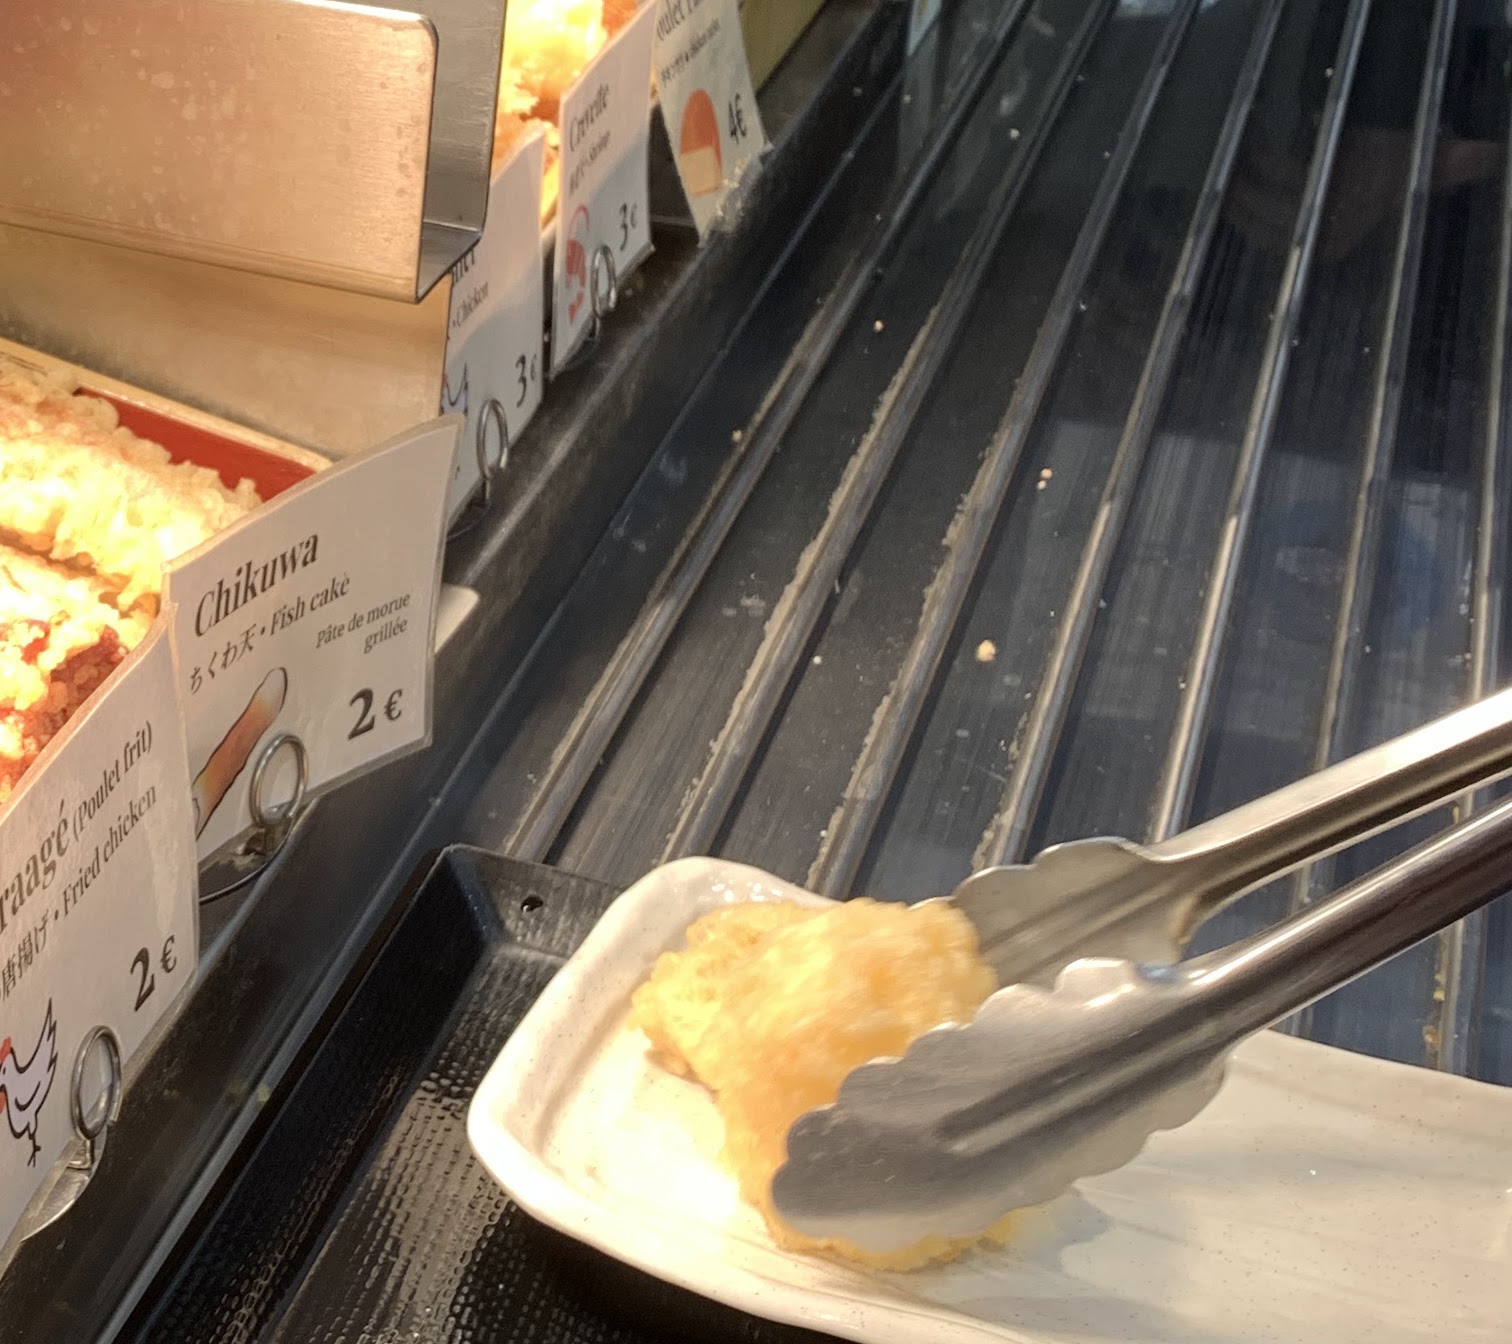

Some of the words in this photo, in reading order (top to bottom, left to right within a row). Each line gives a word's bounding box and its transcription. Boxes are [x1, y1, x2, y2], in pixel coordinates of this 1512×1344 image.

[569, 82, 610, 152] Crevette
[515, 353, 527, 408] 3
[195, 533, 319, 638] Chikuwa
[190, 623, 257, 695] ちくわ天
[269, 596, 306, 636] Fish
[316, 622, 345, 649] Pâte
[347, 613, 364, 633] de
[366, 593, 411, 625] morue
[362, 615, 409, 655] grillée
[347, 687, 376, 741] 2
[72, 758, 122, 842] (Poulet
[122, 721, 153, 775] frit)
[62, 845, 102, 918] Fried
[103, 784, 157, 864] chicken
[130, 946, 156, 1013] 2
